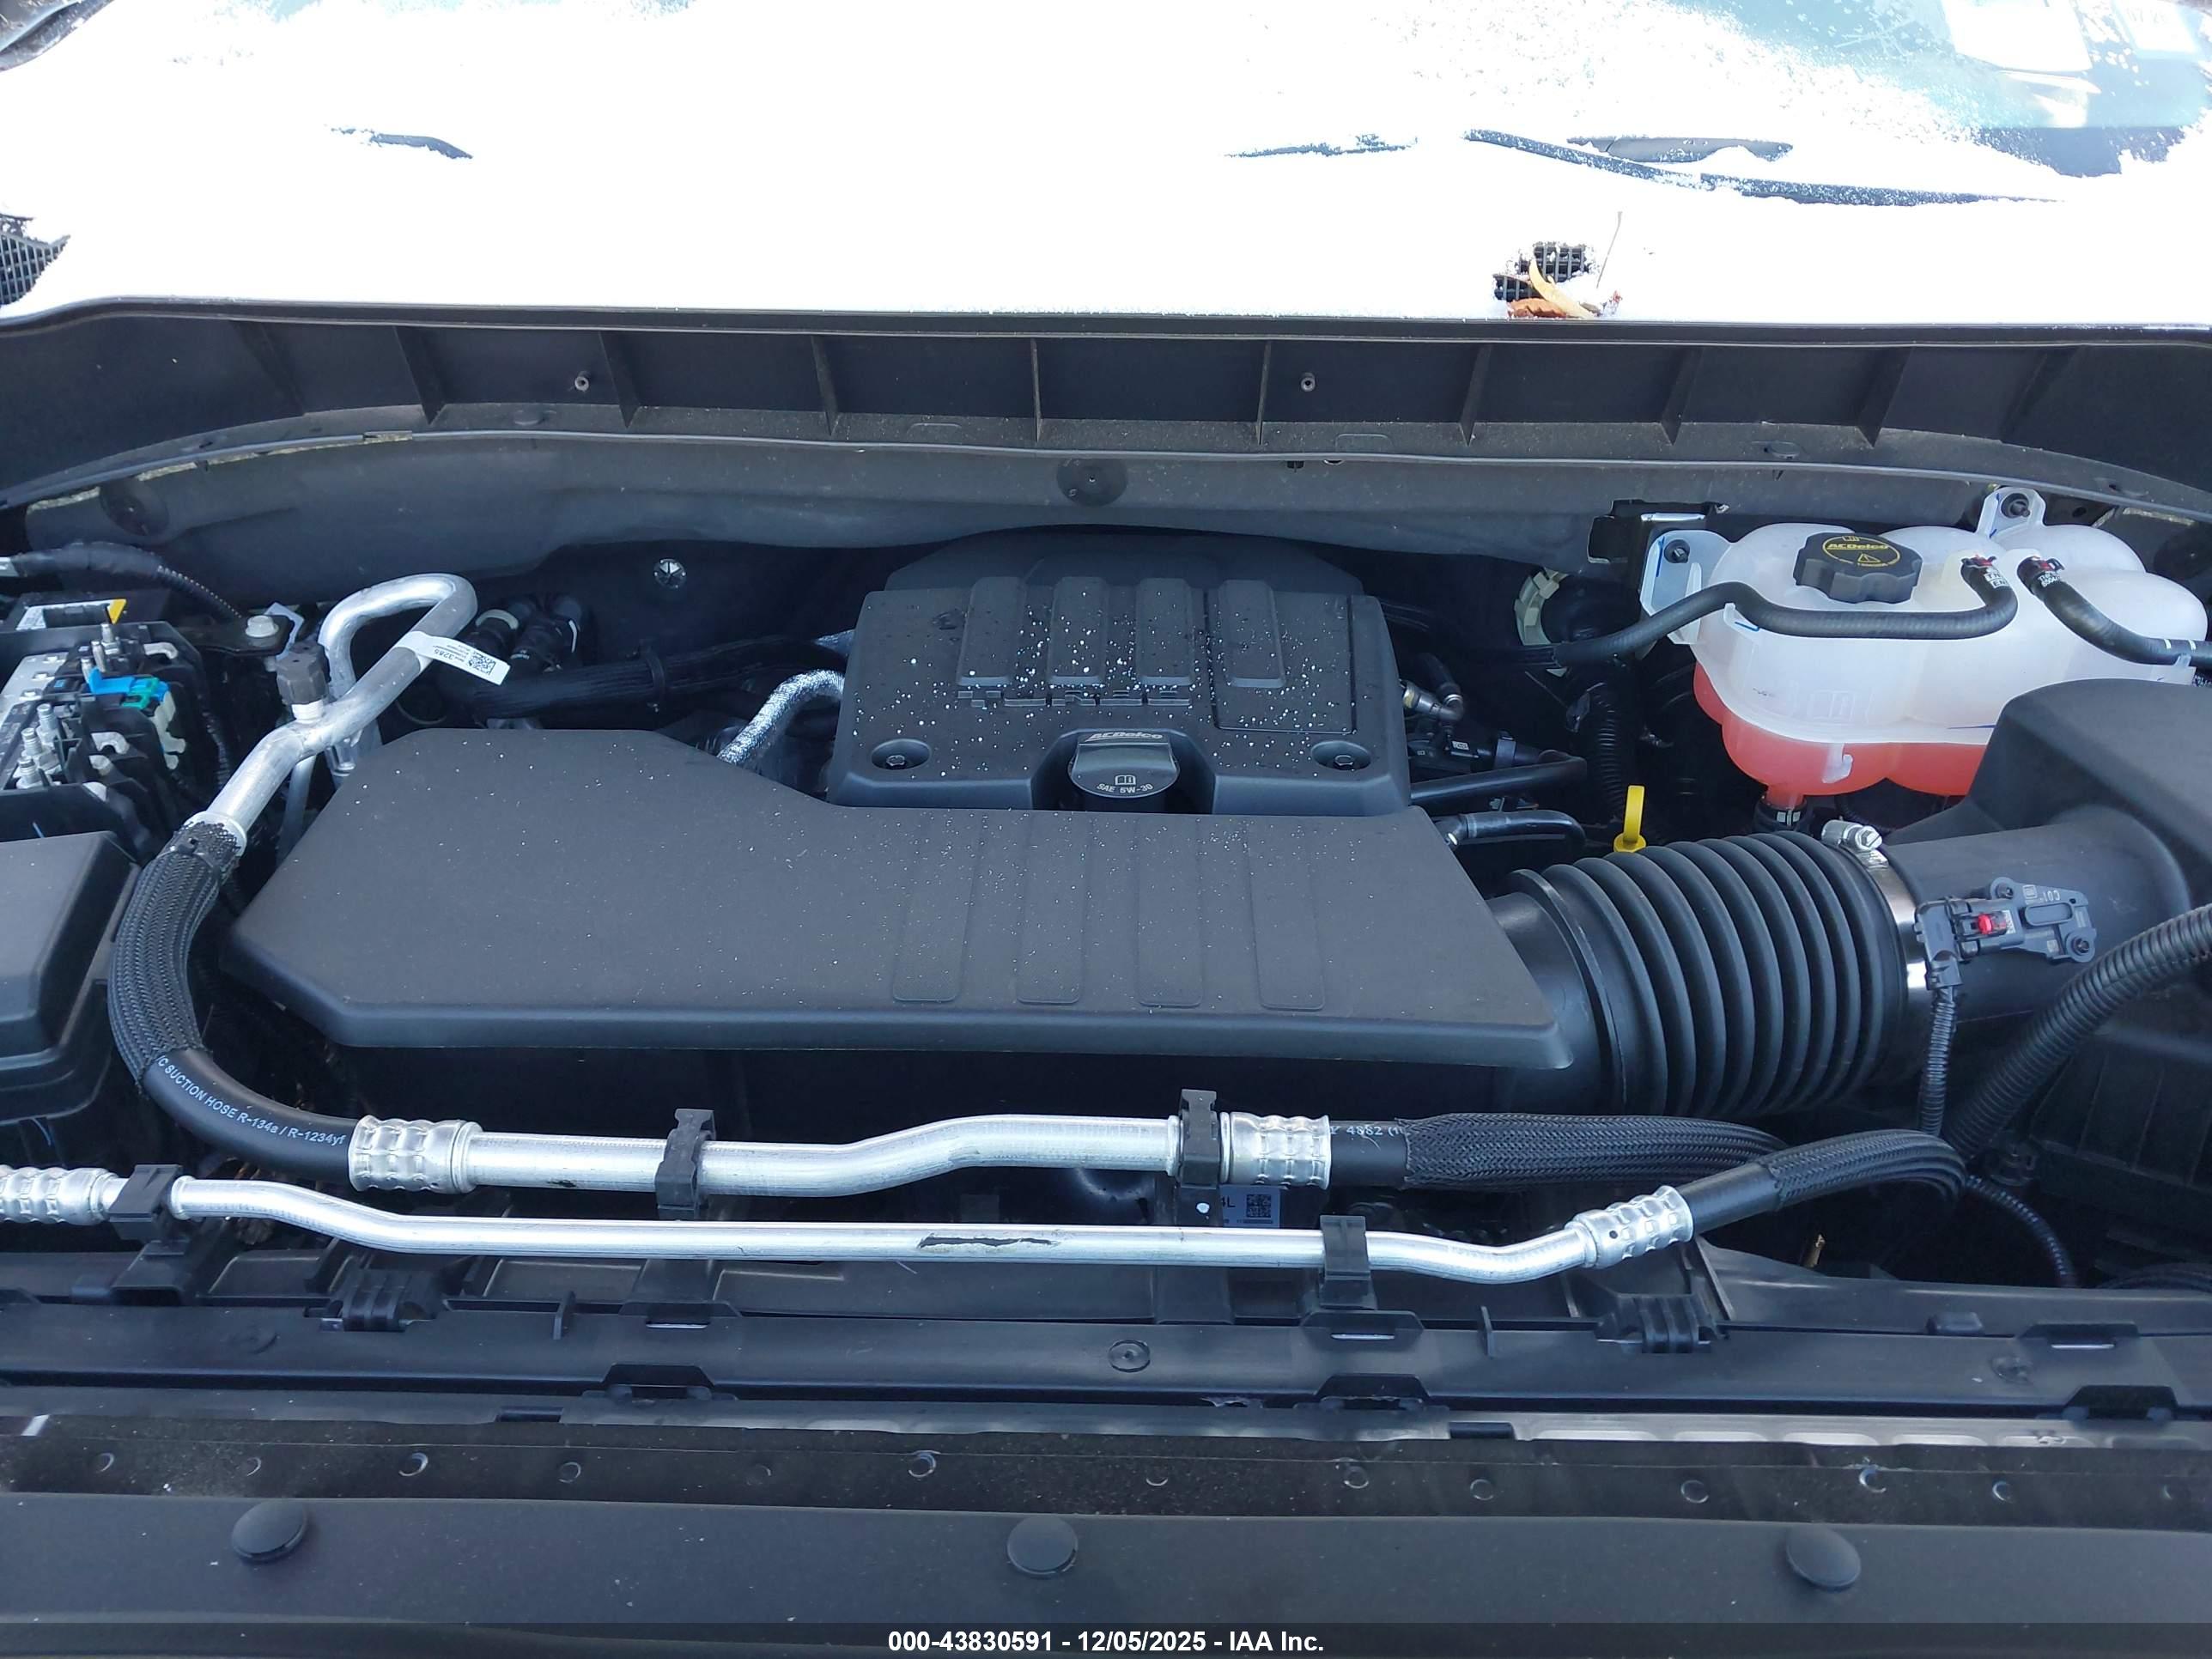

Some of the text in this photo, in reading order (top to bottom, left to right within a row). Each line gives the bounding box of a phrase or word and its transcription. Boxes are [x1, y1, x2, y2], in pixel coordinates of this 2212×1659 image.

[1084, 732, 1164, 742] ACDelco
[1097, 783, 1154, 793] SAE 5W-30
[155, 1055, 347, 1146] /C SUCTION HOSE R-134a / R-1234yf
